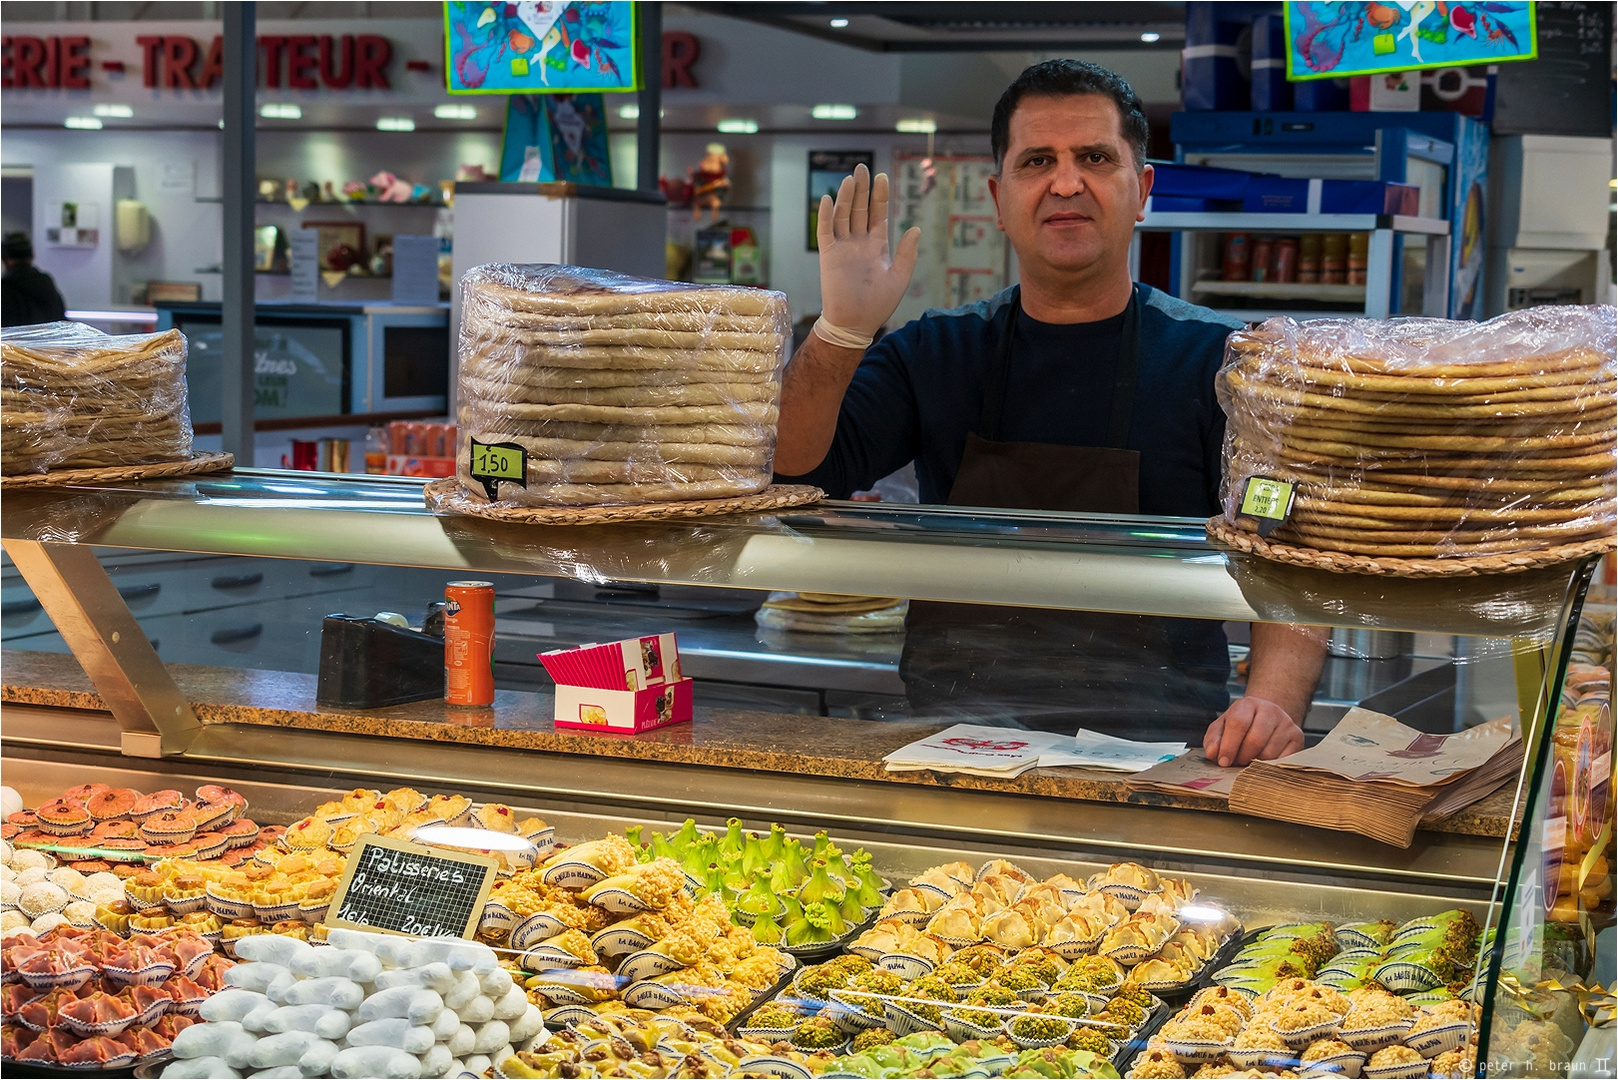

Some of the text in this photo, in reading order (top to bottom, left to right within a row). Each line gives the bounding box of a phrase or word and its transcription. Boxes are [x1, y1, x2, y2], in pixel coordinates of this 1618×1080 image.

[136, 34, 393, 89] TRATEUR
[479, 454, 508, 474] 1,50
[368, 847, 465, 884] Patisseries
[351, 872, 418, 904] Oriental
[401, 914, 456, 938] 20€/k
